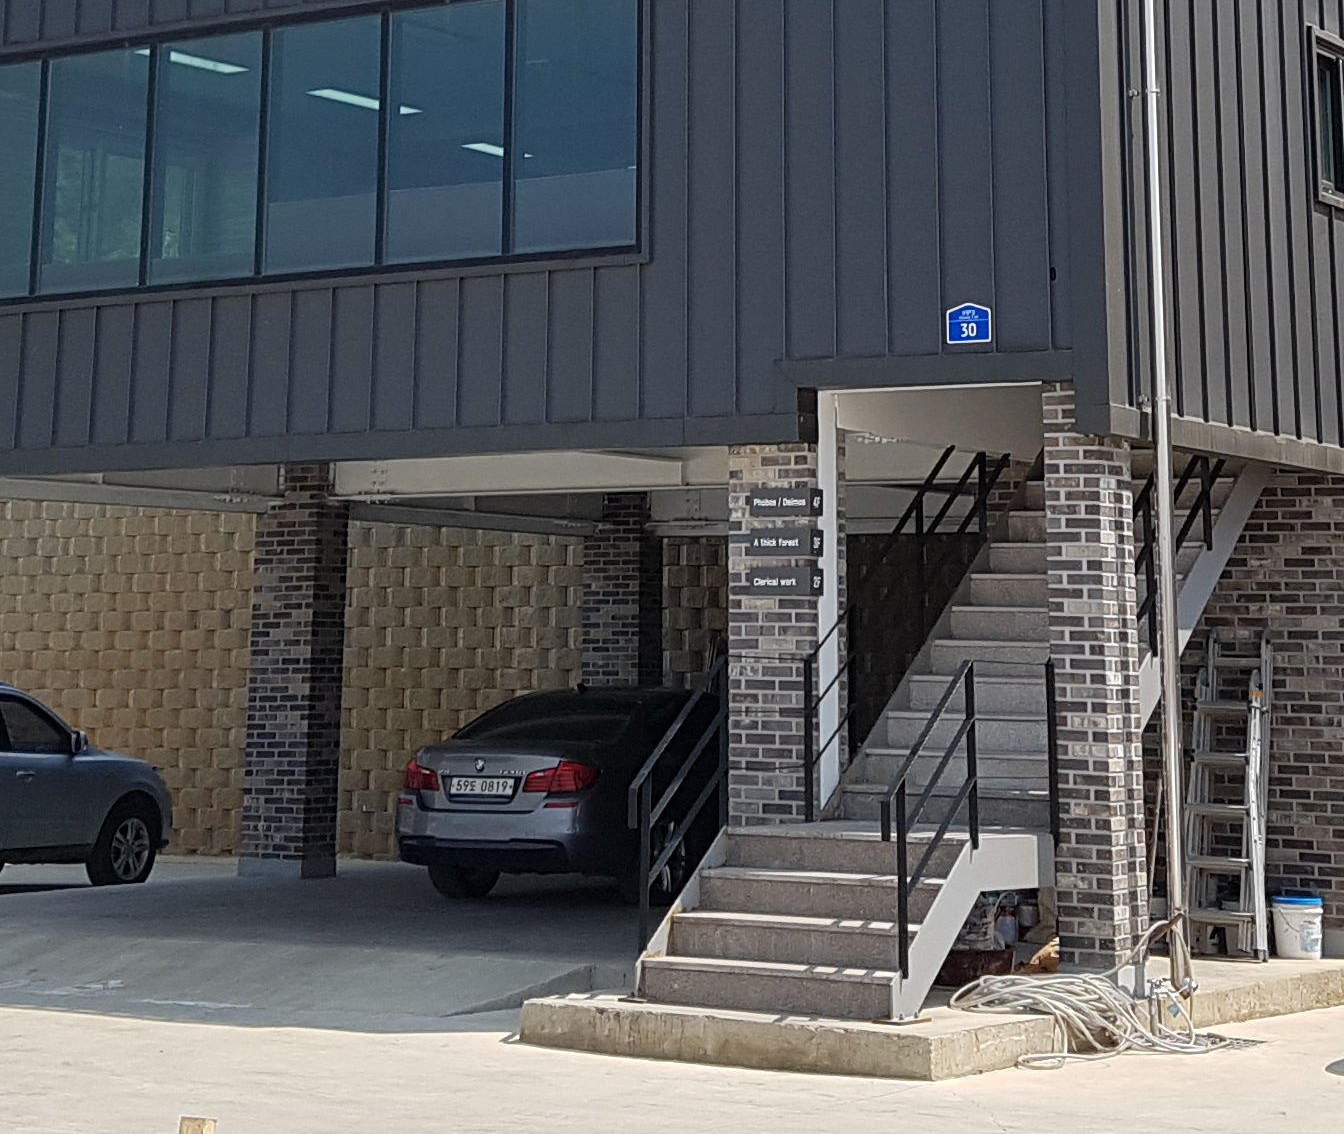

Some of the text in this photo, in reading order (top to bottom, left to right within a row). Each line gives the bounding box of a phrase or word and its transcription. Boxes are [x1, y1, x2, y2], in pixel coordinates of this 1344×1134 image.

[960, 323, 977, 337] 30
[754, 537, 799, 547] A thick forest
[753, 577, 797, 586] Clerical work
[480, 780, 508, 793] 0819
